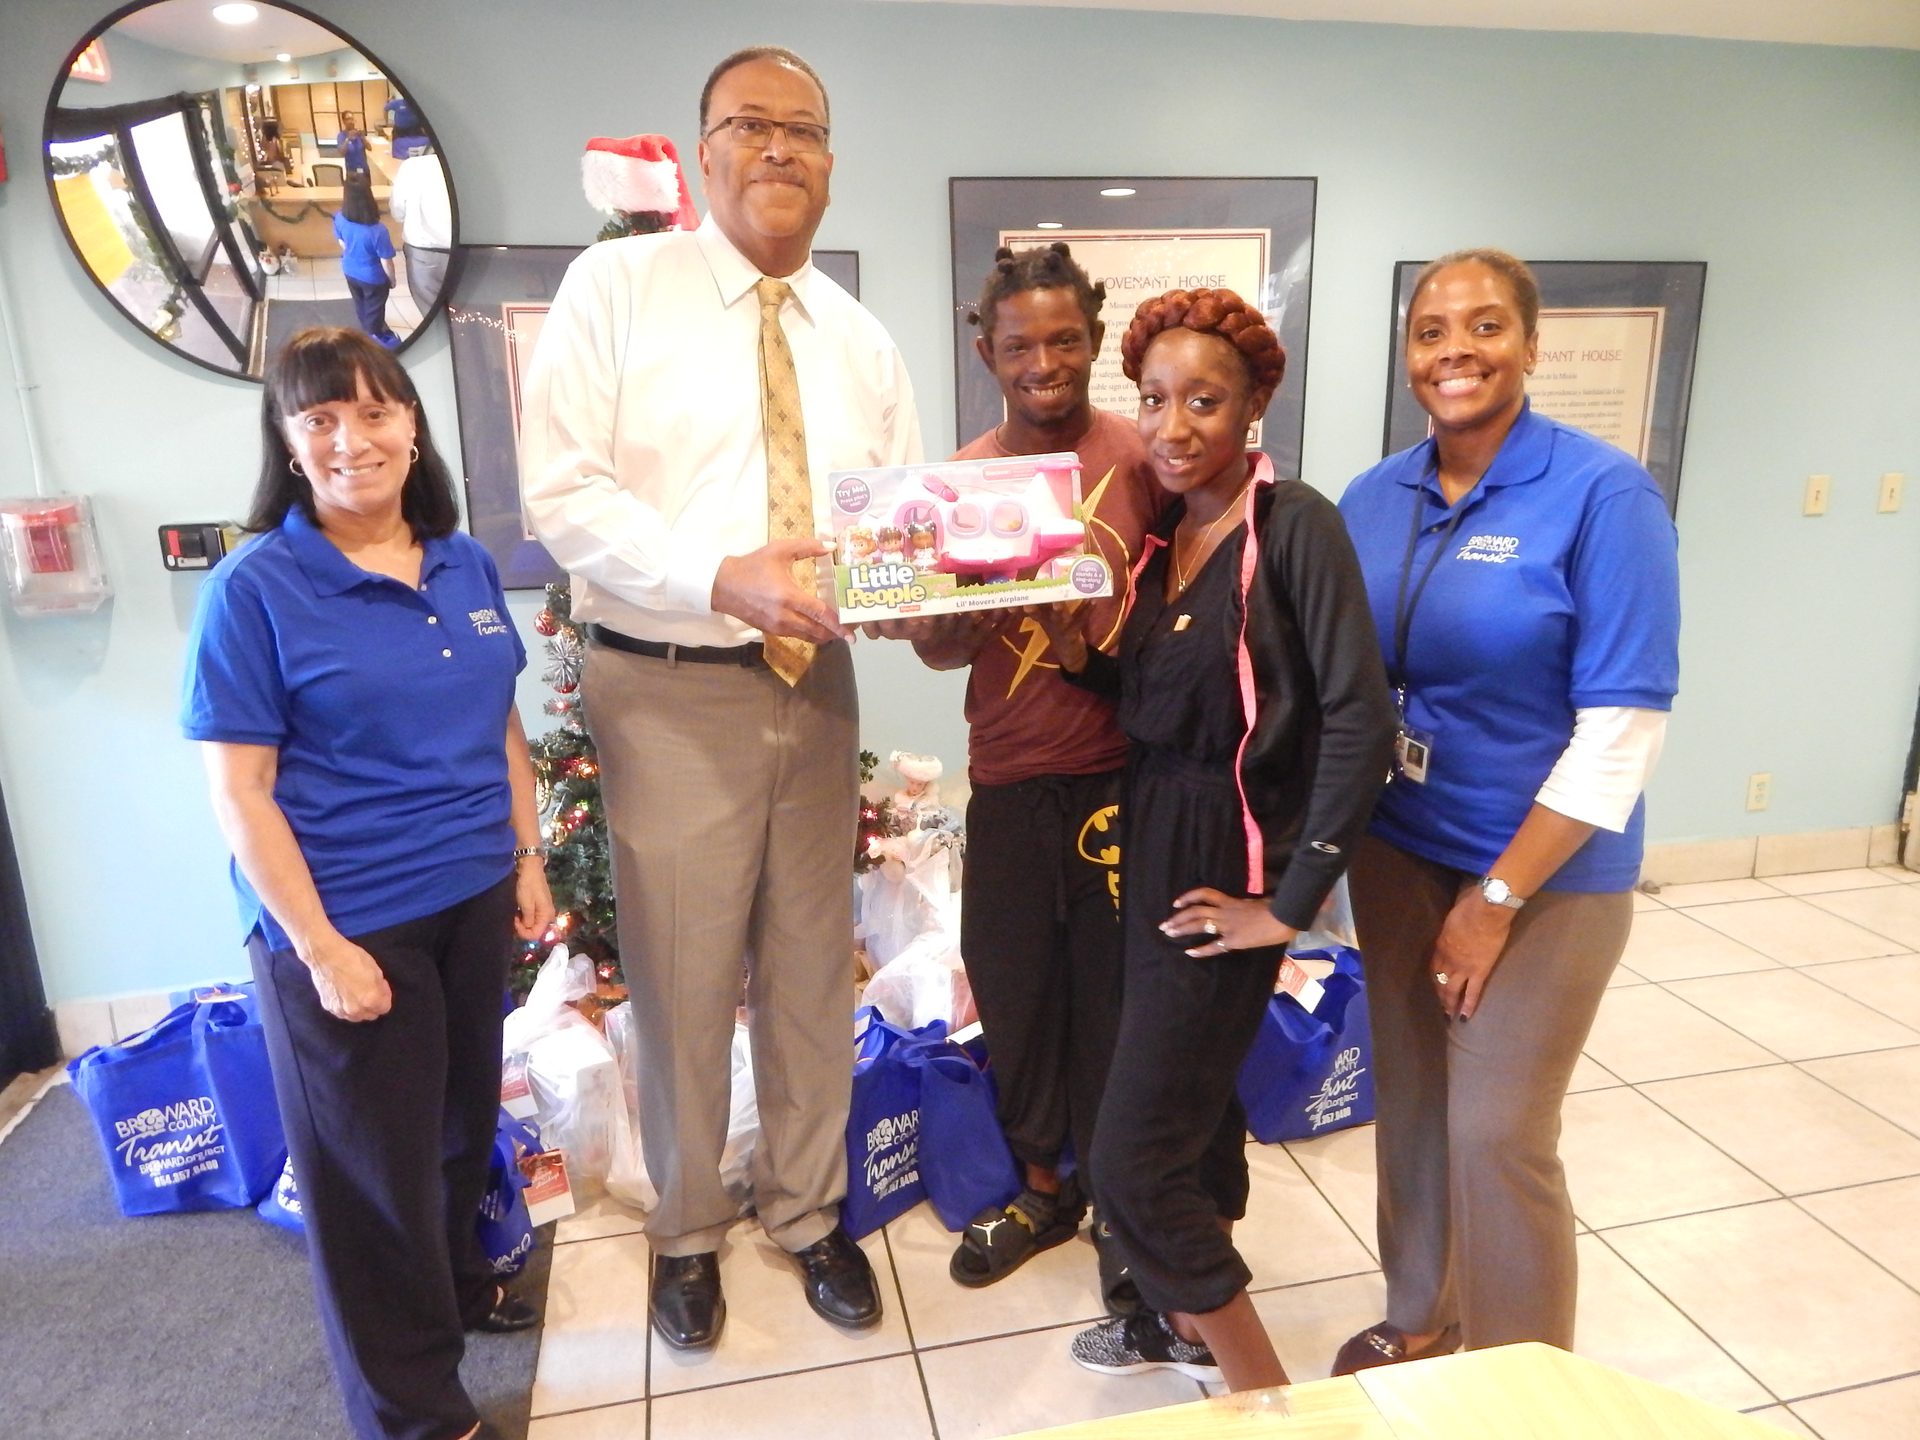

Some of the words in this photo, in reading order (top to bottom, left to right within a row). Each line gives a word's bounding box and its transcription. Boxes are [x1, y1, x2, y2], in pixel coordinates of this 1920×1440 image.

[1178, 274, 1227, 288] HOUSE
[1537, 350, 1576, 363] ENANT
[1581, 349, 1623, 362] HOUSE
[836, 489, 851, 498] Try
[851, 484, 867, 494] Me!
[1456, 545, 1520, 563] Transit
[849, 563, 915, 589] Little
[846, 583, 926, 609] People
[956, 600, 968, 608] Lil'
[999, 595, 1030, 604] Airplane
[115, 1096, 215, 1139] BROWARD
[168, 1112, 217, 1133] COUNTY
[115, 1123, 224, 1166] Transit
